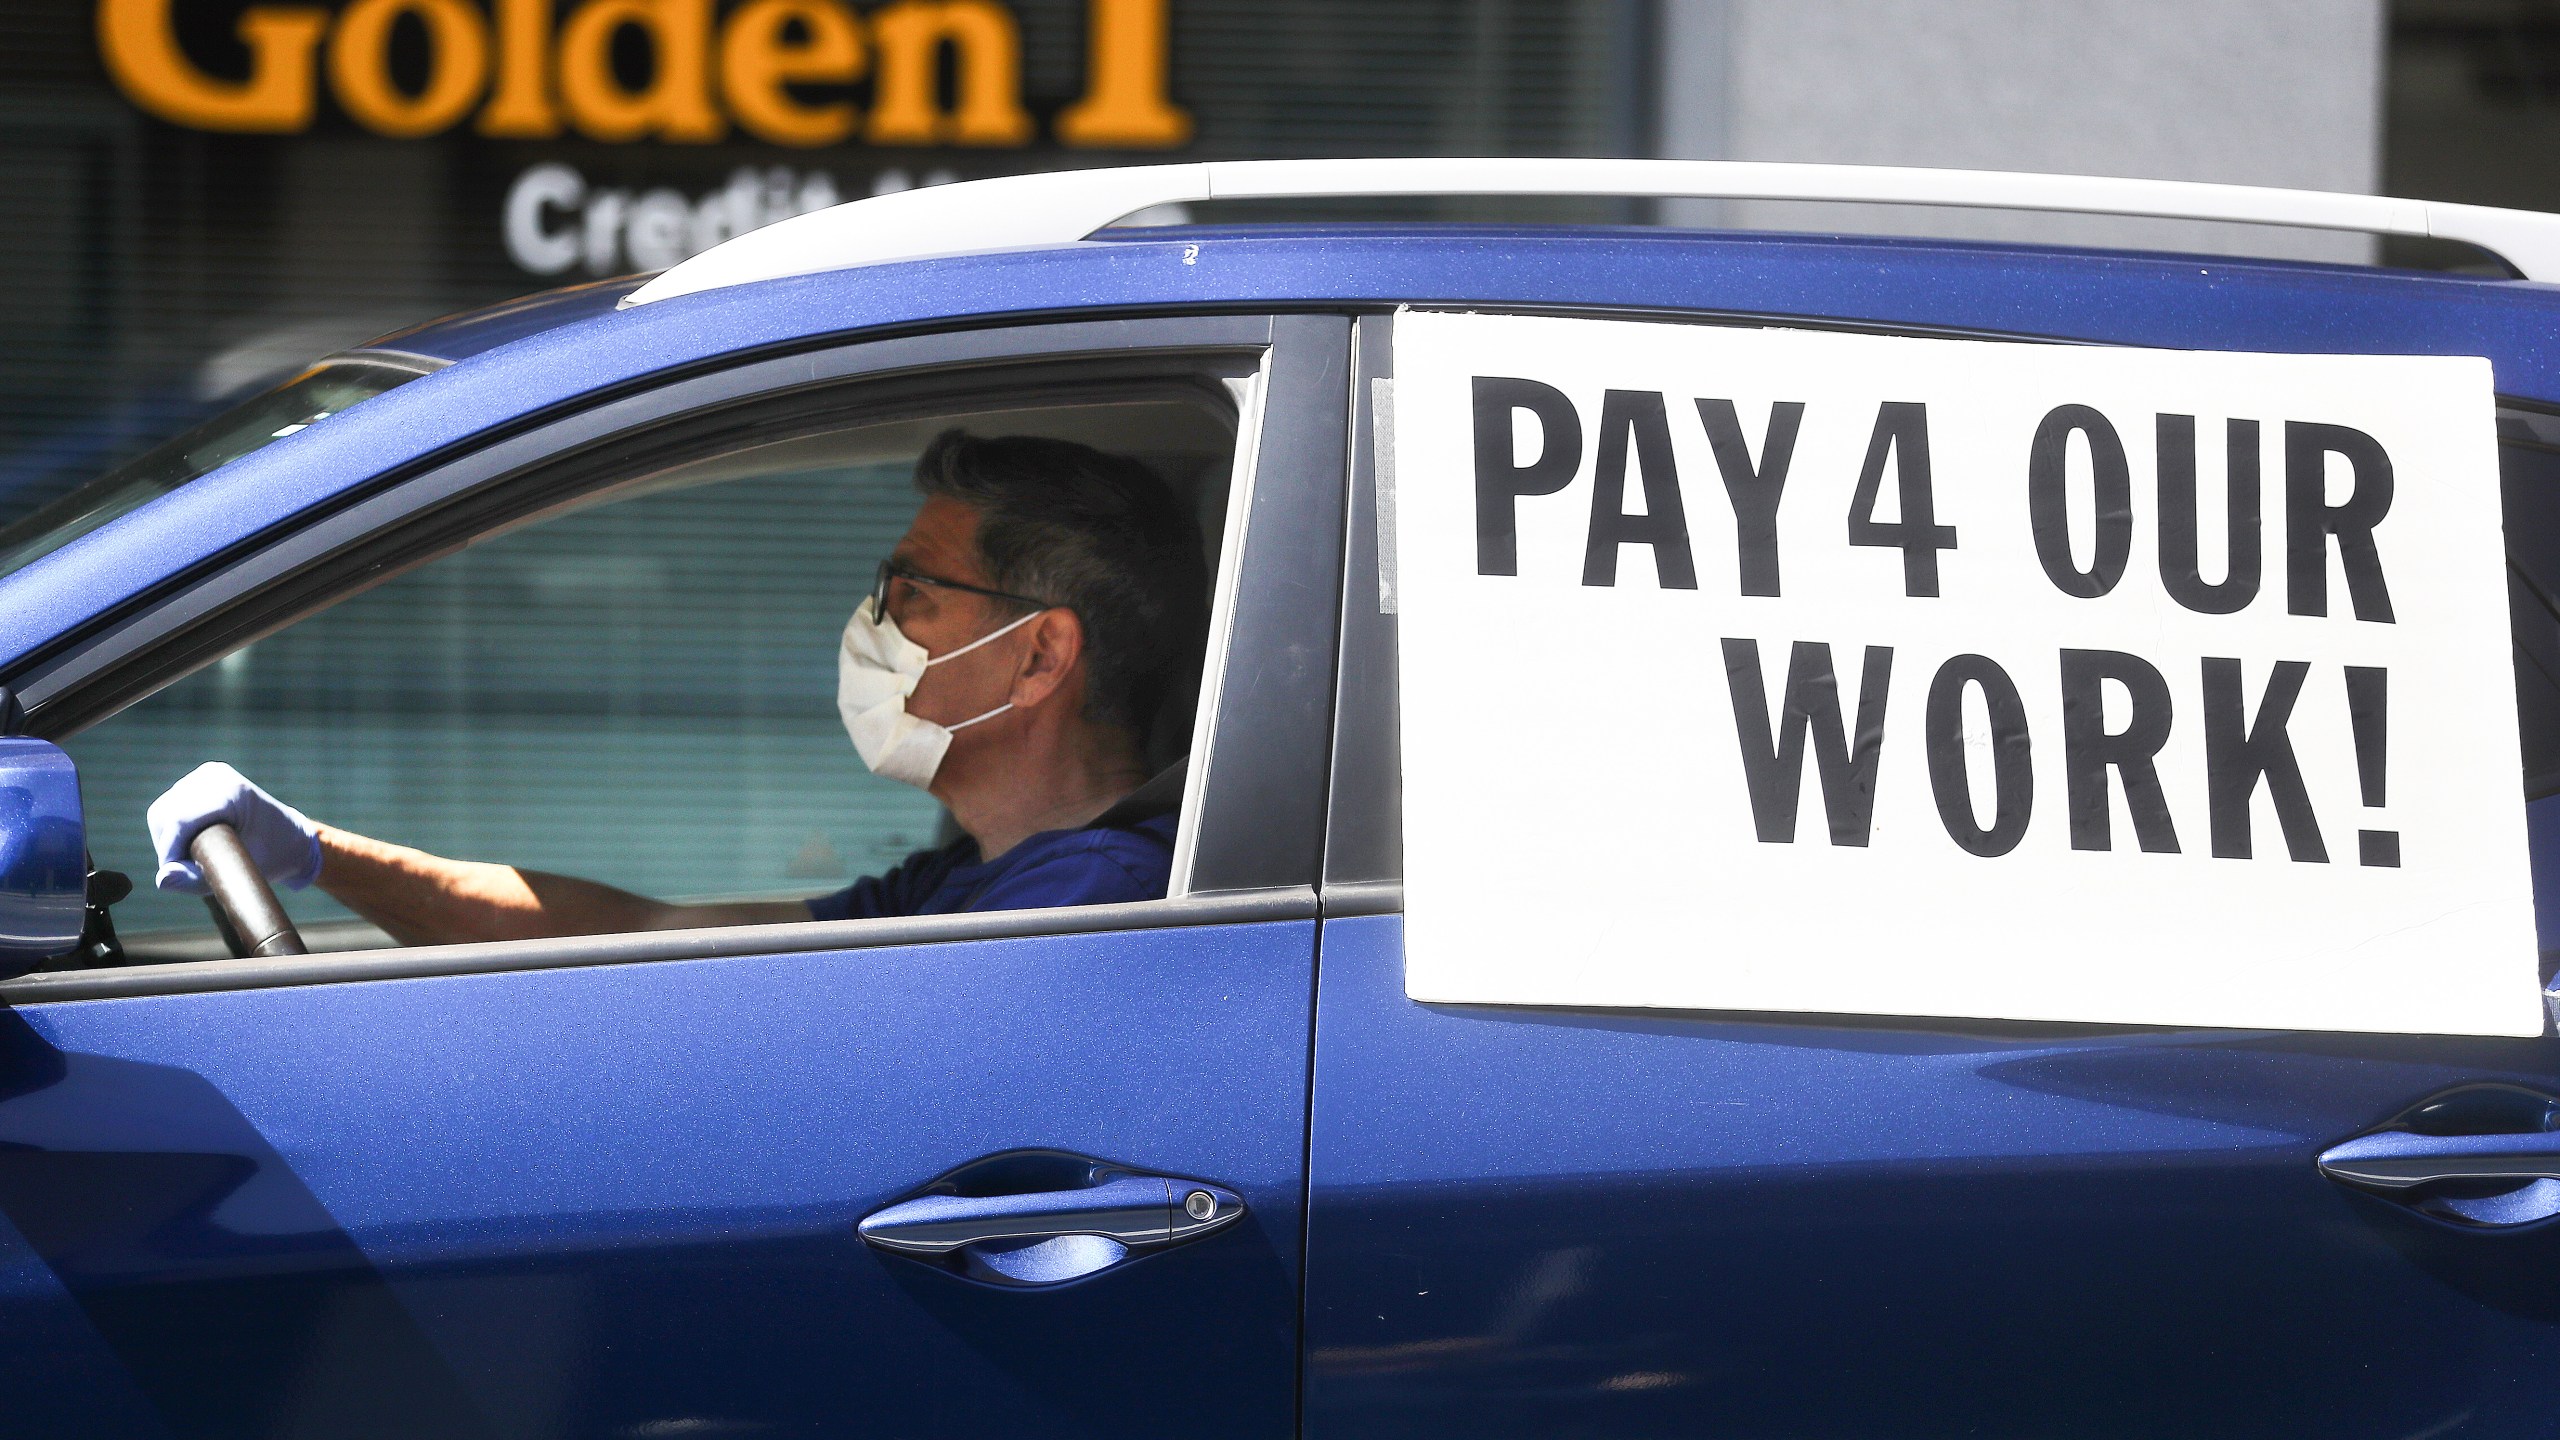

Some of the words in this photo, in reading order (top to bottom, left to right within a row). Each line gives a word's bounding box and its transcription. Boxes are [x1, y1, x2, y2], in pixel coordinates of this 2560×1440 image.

[1471, 375, 1806, 598] PAY
[1847, 401, 1958, 598] 4
[2028, 403, 2397, 625] OUR
[1720, 637, 2402, 868] WORK!
